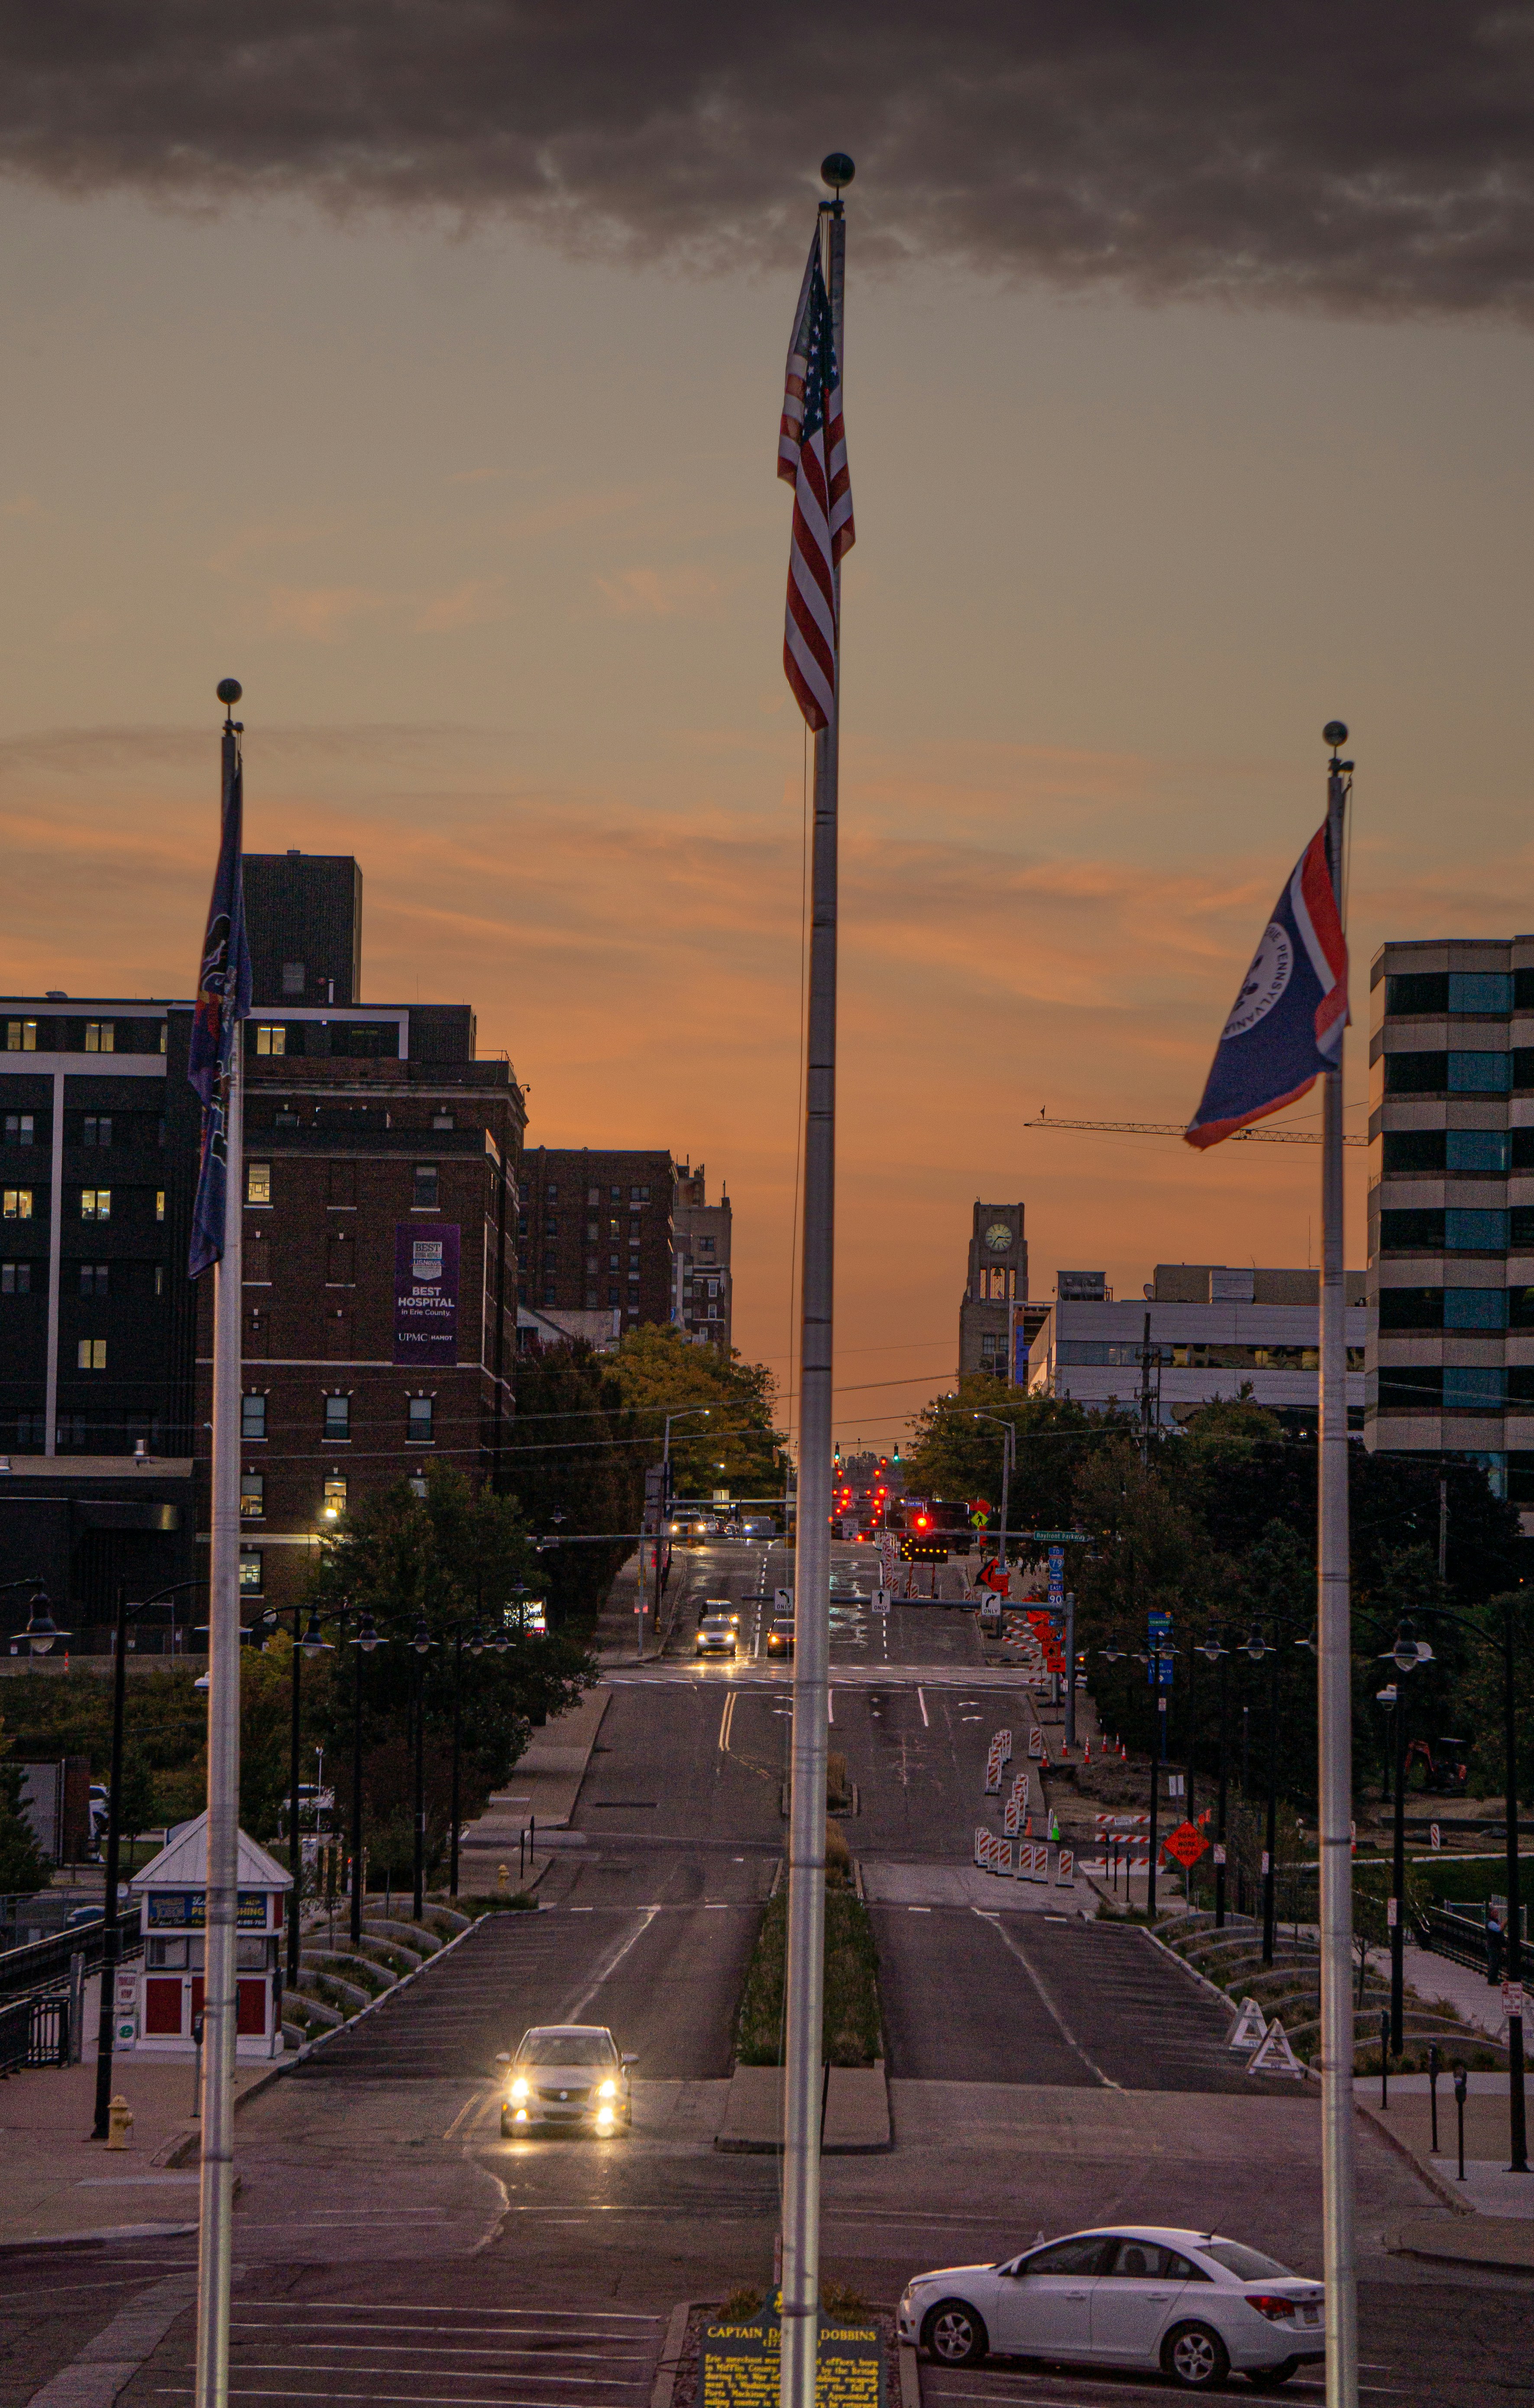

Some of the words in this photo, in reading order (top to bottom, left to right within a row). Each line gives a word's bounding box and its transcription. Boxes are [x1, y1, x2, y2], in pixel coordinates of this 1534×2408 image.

[416, 1243, 440, 1252] BEST
[412, 1287, 441, 1296] BEST
[398, 1297, 455, 1308] HOSPITAL
[398, 1333, 428, 1342] UPMC
[1052, 1559, 1062, 1568] 79
[1049, 1595, 1062, 1603] 90
[707, 2326, 763, 2339] CAPTAIN
[820, 2328, 876, 2341] DOBBINS
